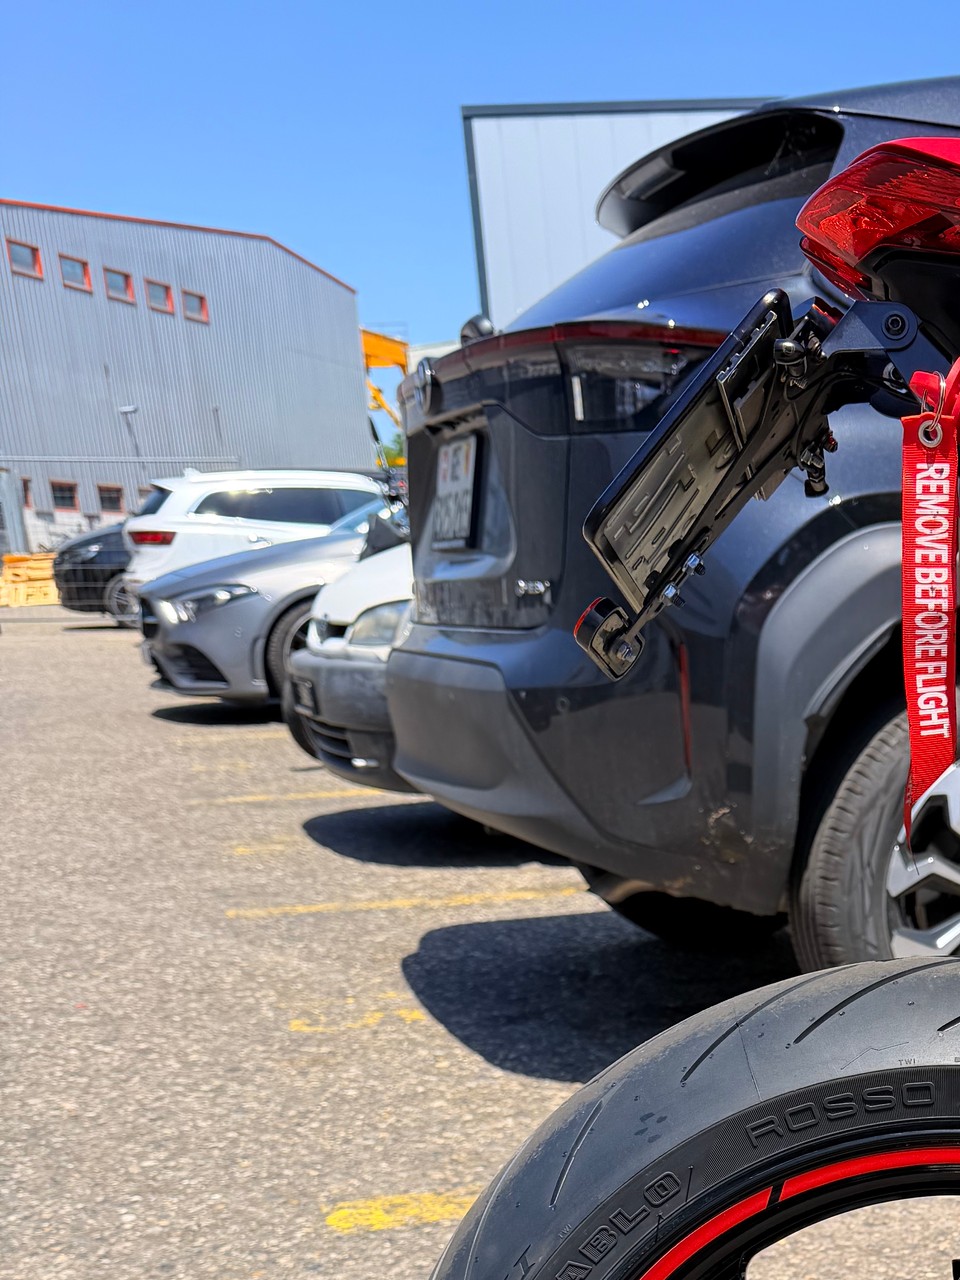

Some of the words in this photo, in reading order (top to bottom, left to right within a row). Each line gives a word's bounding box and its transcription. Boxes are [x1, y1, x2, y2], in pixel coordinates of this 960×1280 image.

[914, 463, 950, 563] REMOVE
[914, 567, 949, 659] BEFORE
[915, 661, 950, 738] FLIGHT
[744, 1081, 936, 1149] ROSSO
